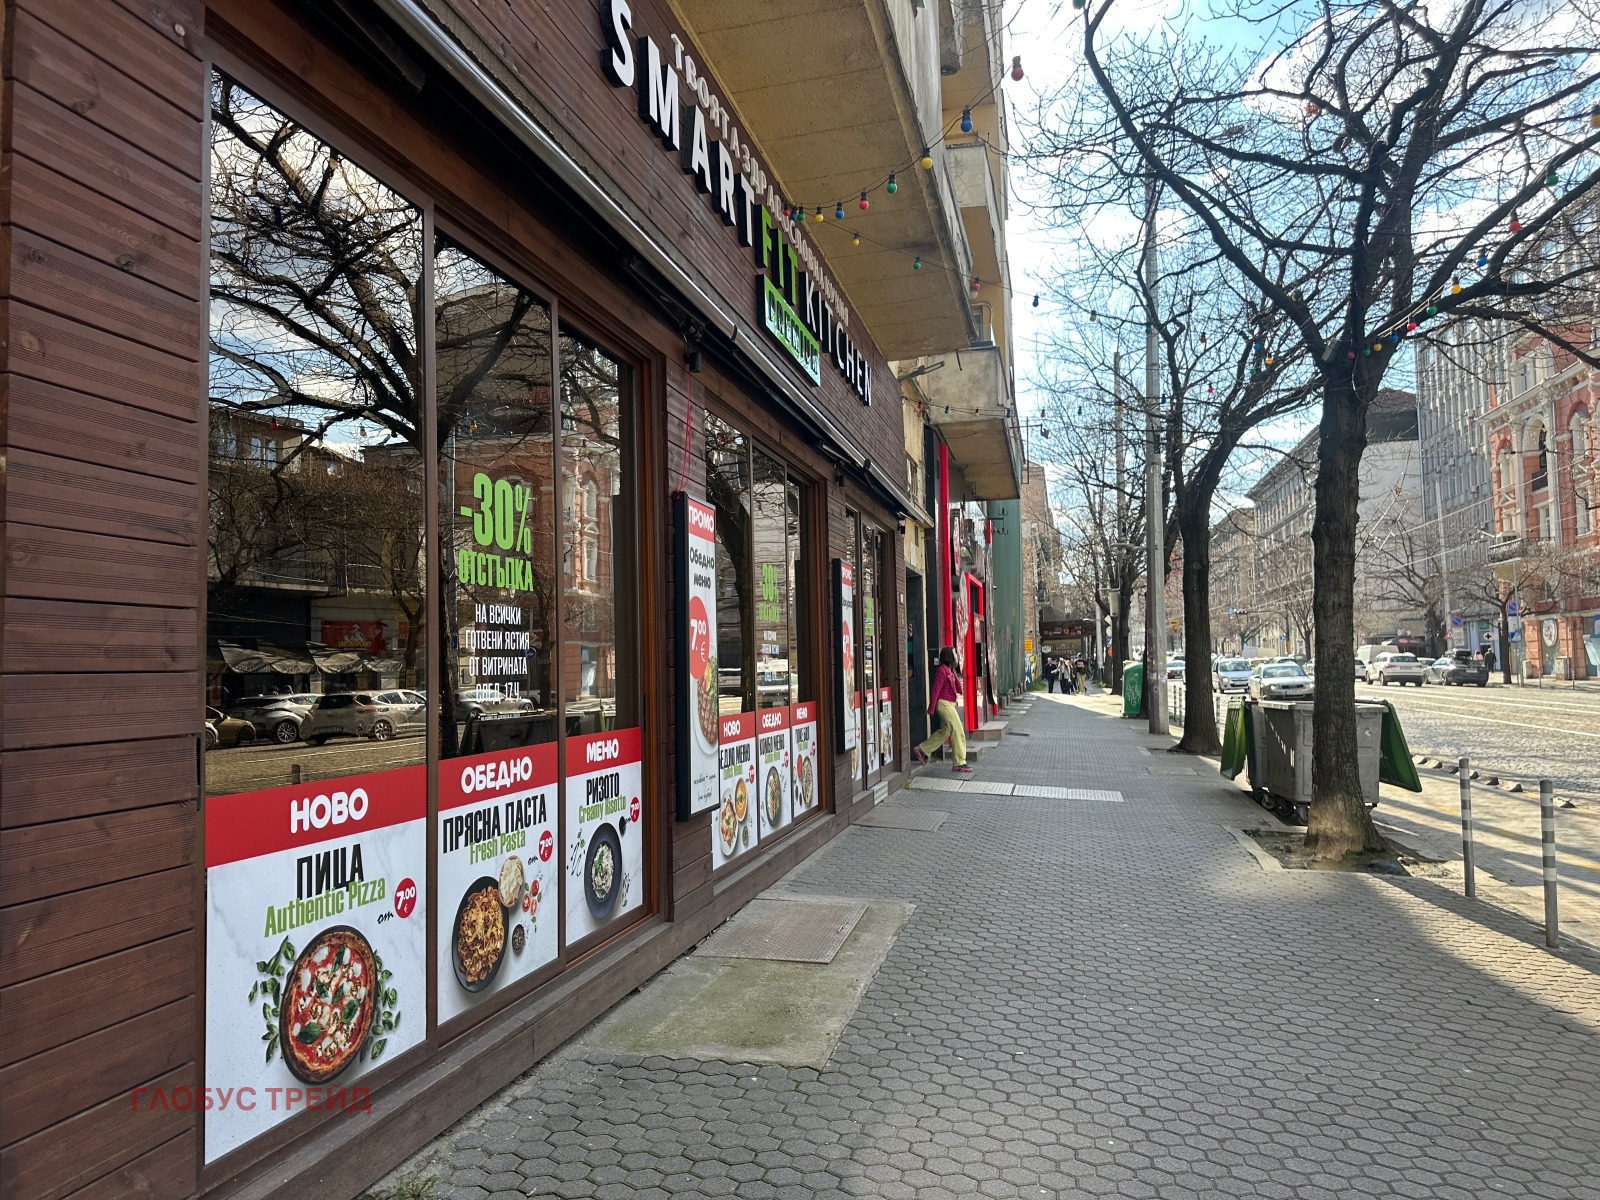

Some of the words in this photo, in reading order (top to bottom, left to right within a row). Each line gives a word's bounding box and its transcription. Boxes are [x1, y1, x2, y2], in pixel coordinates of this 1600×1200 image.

[671, 34, 740, 159] ТВОЯТА
[606, 0, 755, 247] SMART
[758, 204, 798, 306] FIT
[804, 271, 872, 407] KITCHEN
[768, 290, 819, 376] PREMIUM
[460, 472, 531, 555] -30%
[688, 505, 715, 533] ПРОМО
[458, 548, 534, 592] ОТСТЪПКА
[690, 547, 715, 569] Обедно
[475, 603, 487, 623] НА
[489, 605, 521, 625] ВСИЧКИ
[465, 630, 503, 650] ГОТВЕНИ
[504, 631, 530, 650] ЯСТИЯ
[469, 657, 480, 676] ОТ
[482, 657, 528, 676] ВИТРИНАТА
[723, 720, 741, 737] НОВО
[586, 739, 619, 763] МЕНЮ
[461, 756, 533, 794] ОБЕДНО
[586, 772, 620, 805] РИЗОТО
[290, 788, 369, 834] НОВО
[443, 805, 501, 854] ПРЯСНА
[505, 794, 547, 834] ПАСТА
[579, 801, 604, 824] Creamy
[605, 794, 627, 815] Risotto
[470, 836, 498, 865] Fresh
[500, 829, 526, 854] Pasta
[297, 843, 364, 900] ПИЦА
[264, 886, 345, 938] Authentic
[348, 877, 386, 910] Pizza
[396, 887, 416, 910] 7.00
